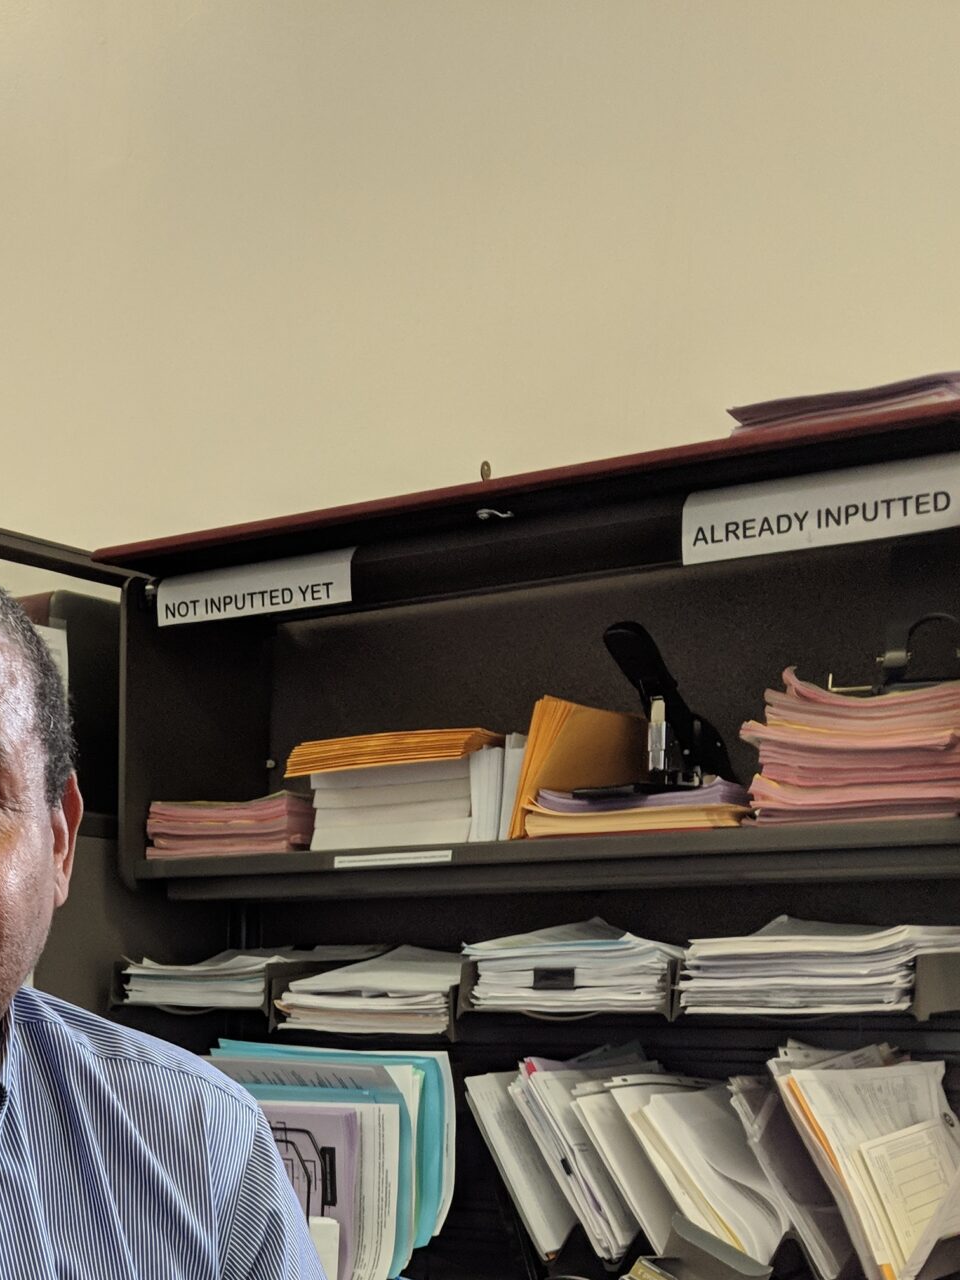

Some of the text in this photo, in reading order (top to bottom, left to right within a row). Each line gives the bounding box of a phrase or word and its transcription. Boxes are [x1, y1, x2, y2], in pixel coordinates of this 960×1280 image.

[692, 491, 951, 547] ALREADY INPUTTED
[165, 581, 334, 619] NOT INPUTTED YET
